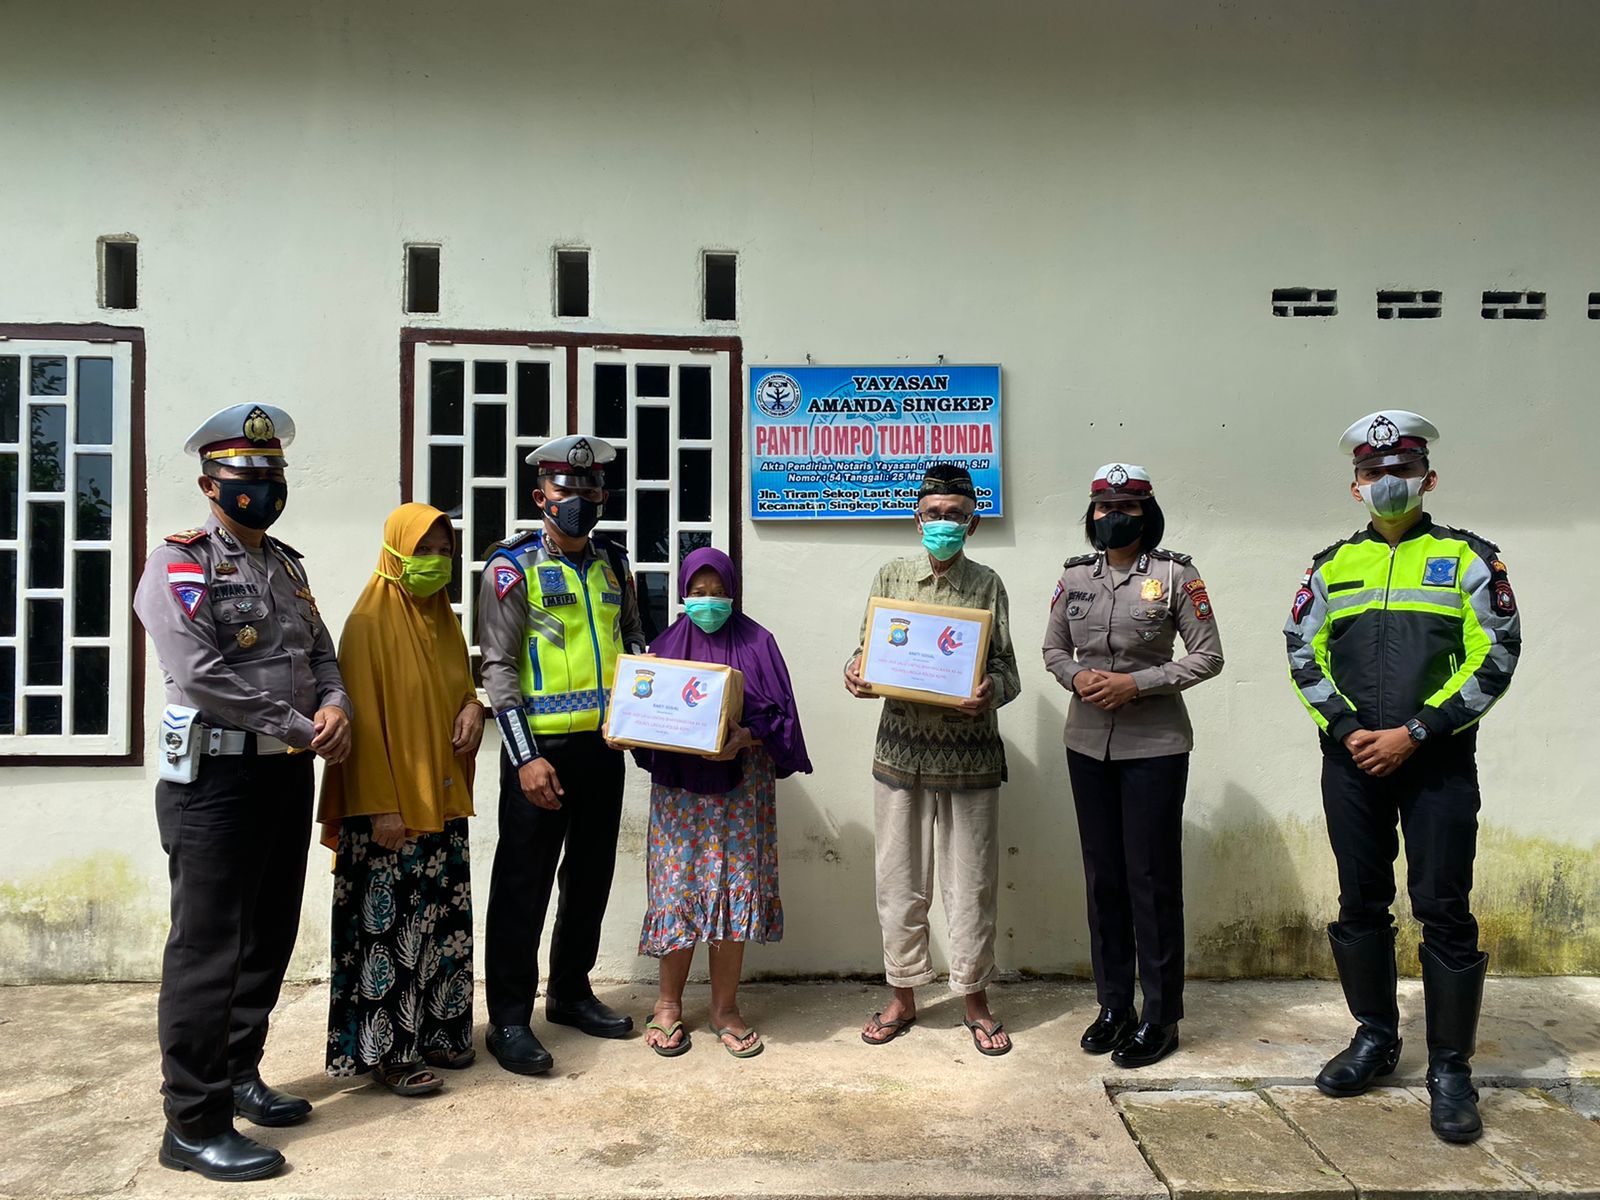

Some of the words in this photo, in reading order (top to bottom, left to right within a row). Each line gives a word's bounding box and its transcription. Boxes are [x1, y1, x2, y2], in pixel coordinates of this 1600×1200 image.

[852, 376, 949, 391] YAYASAN
[807, 398, 897, 413] AMANDA
[902, 397, 994, 412] SINGKEP
[755, 426, 808, 456] PANTI
[812, 425, 874, 456] JOMPO
[877, 425, 926, 455] TUAH
[930, 424, 993, 454] BUNDA
[761, 462, 785, 471] Akta
[787, 462, 834, 471] Pendirian
[836, 462, 872, 471] Notaris
[875, 461, 917, 472] Yayasan
[971, 459, 989, 469] S.H
[788, 473, 821, 482] Nomor
[829, 473, 841, 482] 54
[845, 472, 883, 483] Tanggal
[892, 472, 905, 481] 25
[907, 472, 925, 481] Mar
[758, 489, 781, 499] Jln.
[783, 489, 820, 499] Tiram
[822, 488, 860, 501] Sekop
[863, 488, 891, 498] Laut
[829, 500, 879, 512] Singkep
